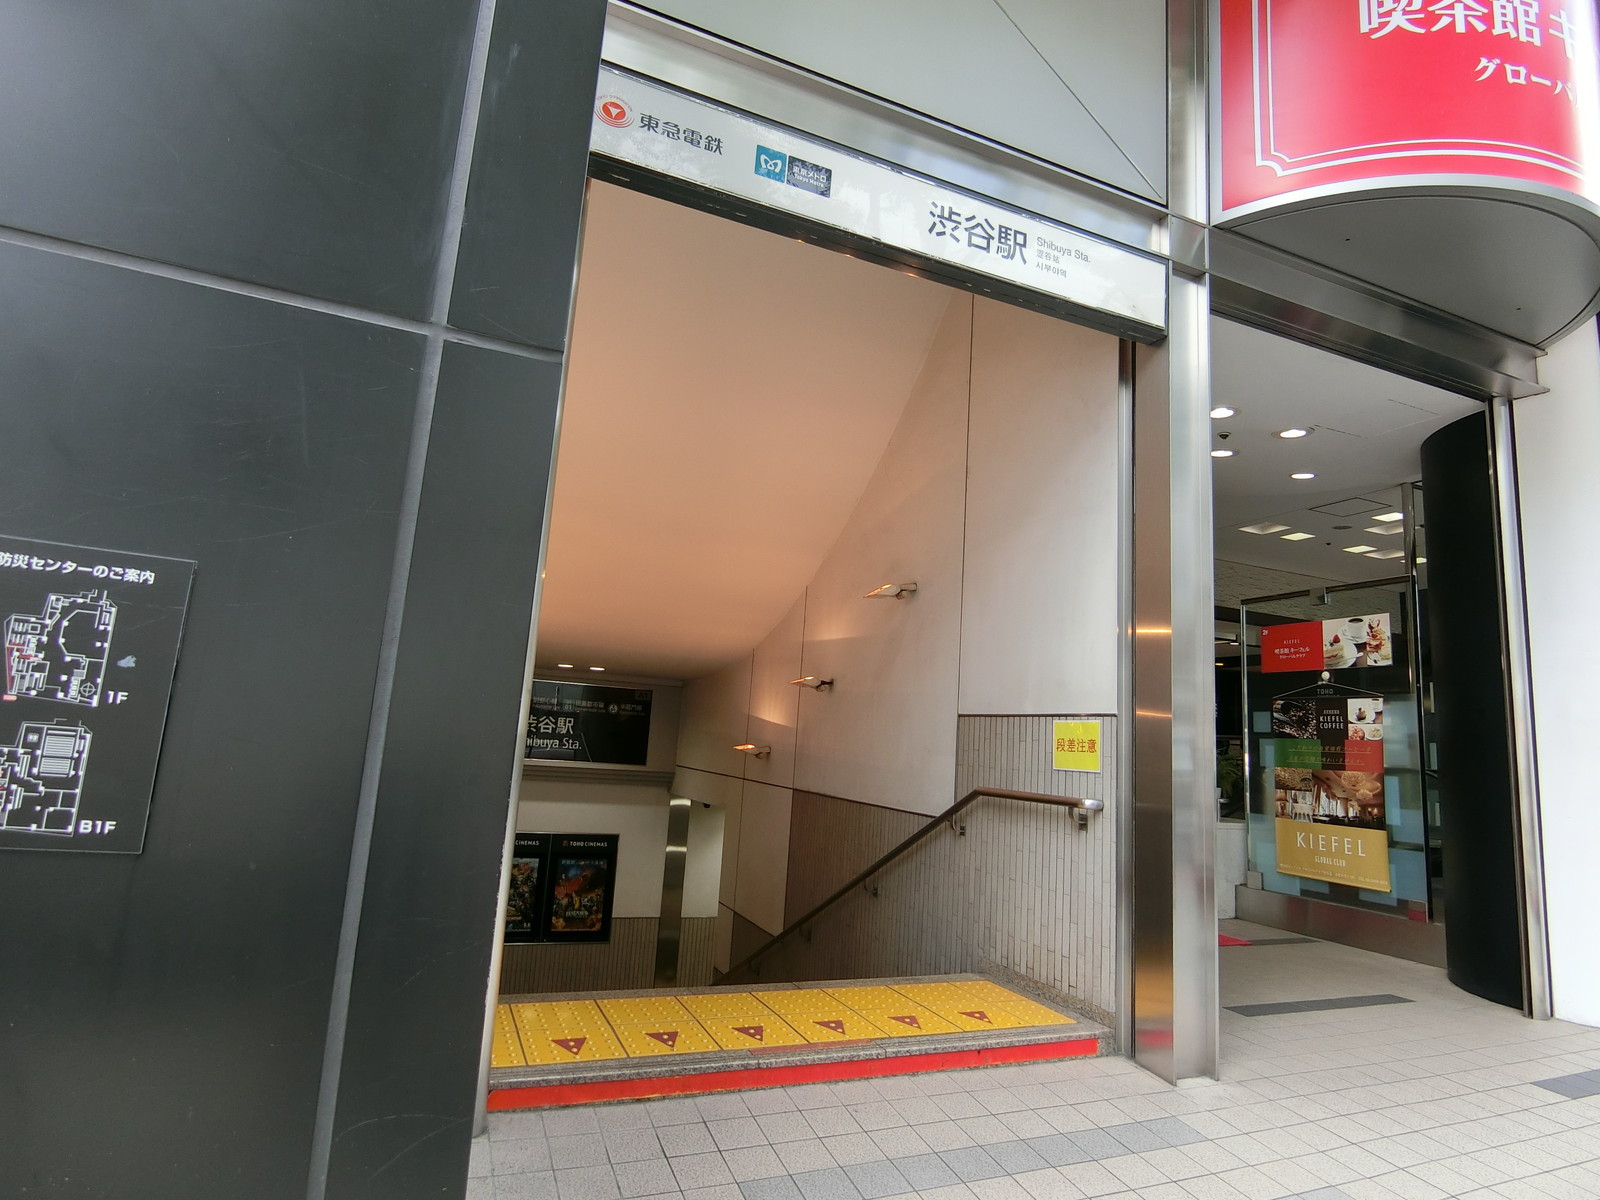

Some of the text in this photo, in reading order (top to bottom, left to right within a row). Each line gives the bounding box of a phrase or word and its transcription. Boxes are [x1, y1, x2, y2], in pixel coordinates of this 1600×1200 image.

[1359, 0, 1542, 47] 喫茶館
[1474, 57, 1578, 107] グローバ
[639, 112, 724, 156] 東急電鉄
[793, 165, 827, 183] 東京メトロ
[794, 174, 824, 188] Tokyo Metro
[928, 201, 1028, 265] 渋谷駅
[1036, 236, 1091, 263] Shibuya Sta.
[1036, 262, 1067, 278] 시부야역
[106, 690, 129, 705] 1F
[1319, 722, 1344, 730] COFFEE
[562, 737, 582, 750] Sta.
[1056, 738, 1097, 753] 段差注意
[79, 820, 117, 835] B1F
[1296, 832, 1366, 857] KIEFEL
[1314, 855, 1346, 867] GLOBAL CLUB
